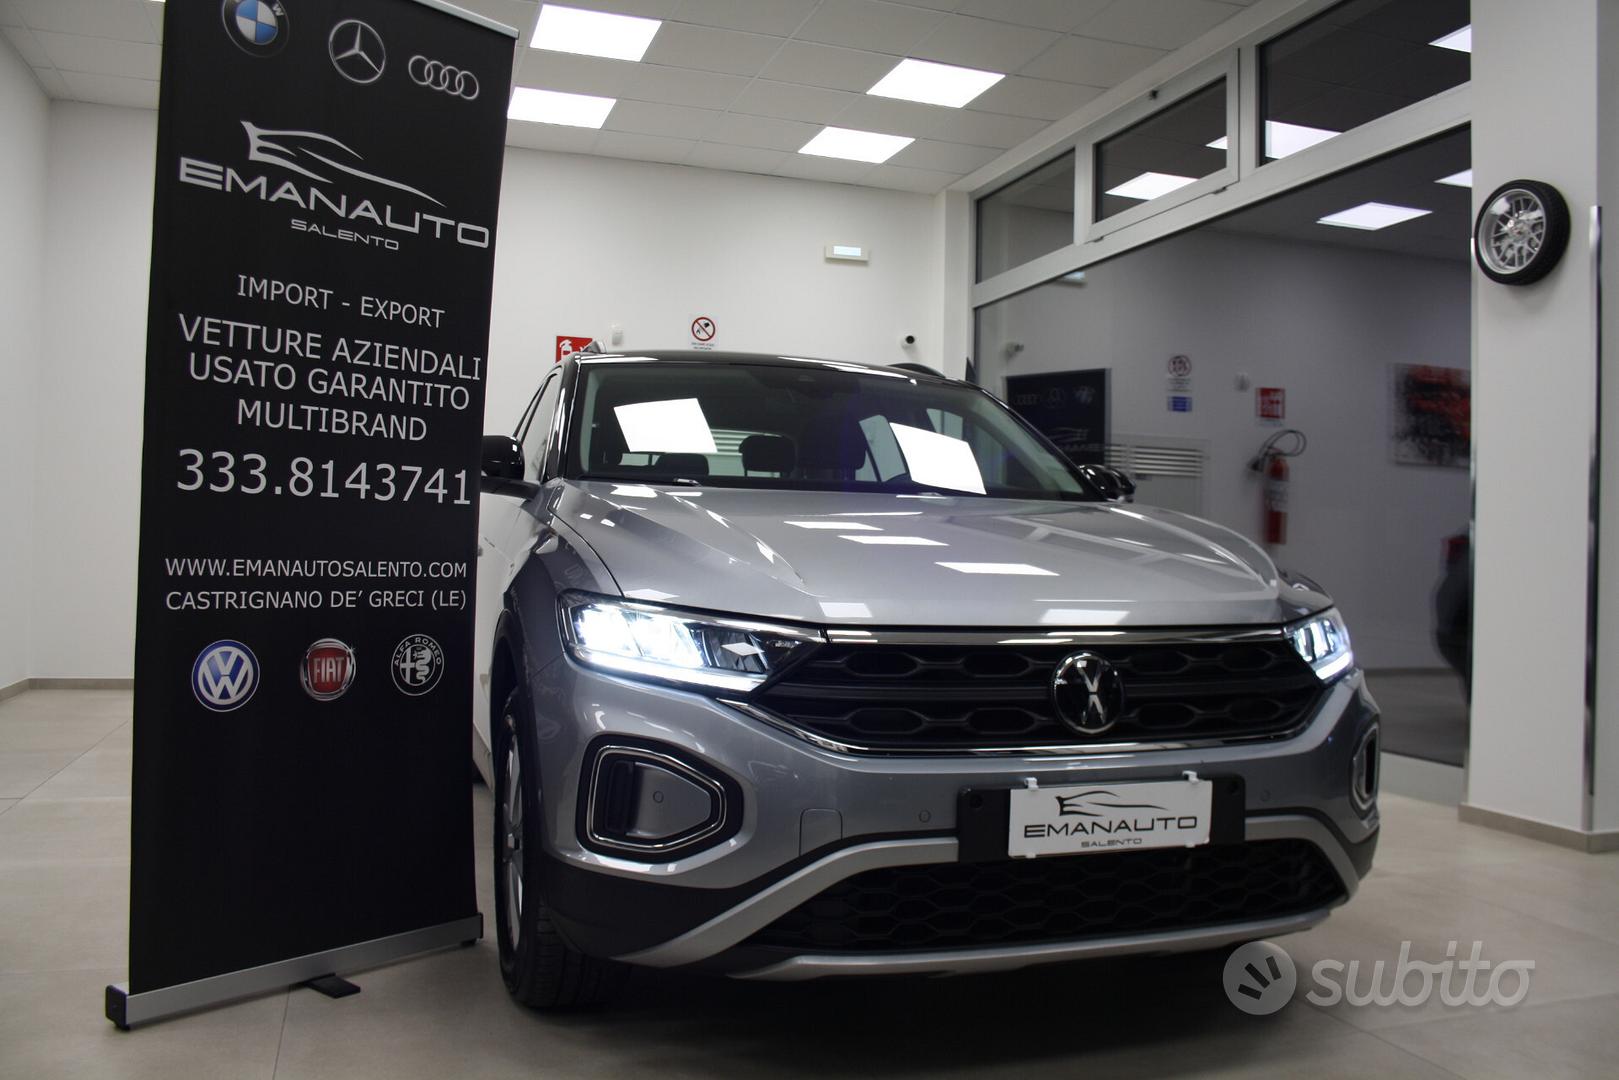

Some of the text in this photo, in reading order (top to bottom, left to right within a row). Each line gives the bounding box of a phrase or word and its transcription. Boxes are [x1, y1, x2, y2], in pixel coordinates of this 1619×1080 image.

[179, 156, 490, 249] EMANAUTO
[290, 218, 400, 251] SALENTO
[237, 274, 334, 310] IMPORT
[360, 296, 446, 329] EXPORT
[178, 313, 482, 381] VETTURE AZIENDALI
[189, 352, 471, 411] USATO GARANTITO
[237, 398, 427, 442] MULTIBRAND
[176, 448, 472, 505] 333.8143741
[165, 558, 468, 578] WWW.EMANAUTOSALENTO.COM
[165, 590, 323, 610] CASTRIGNANO
[368, 590, 424, 608] GRECI
[431, 589, 467, 610] (LE)
[414, 637, 442, 666] ROMEO
[313, 657, 345, 683] FIAT
[1023, 816, 1198, 838] EMANAUTO
[1080, 838, 1143, 848] SALENTO
